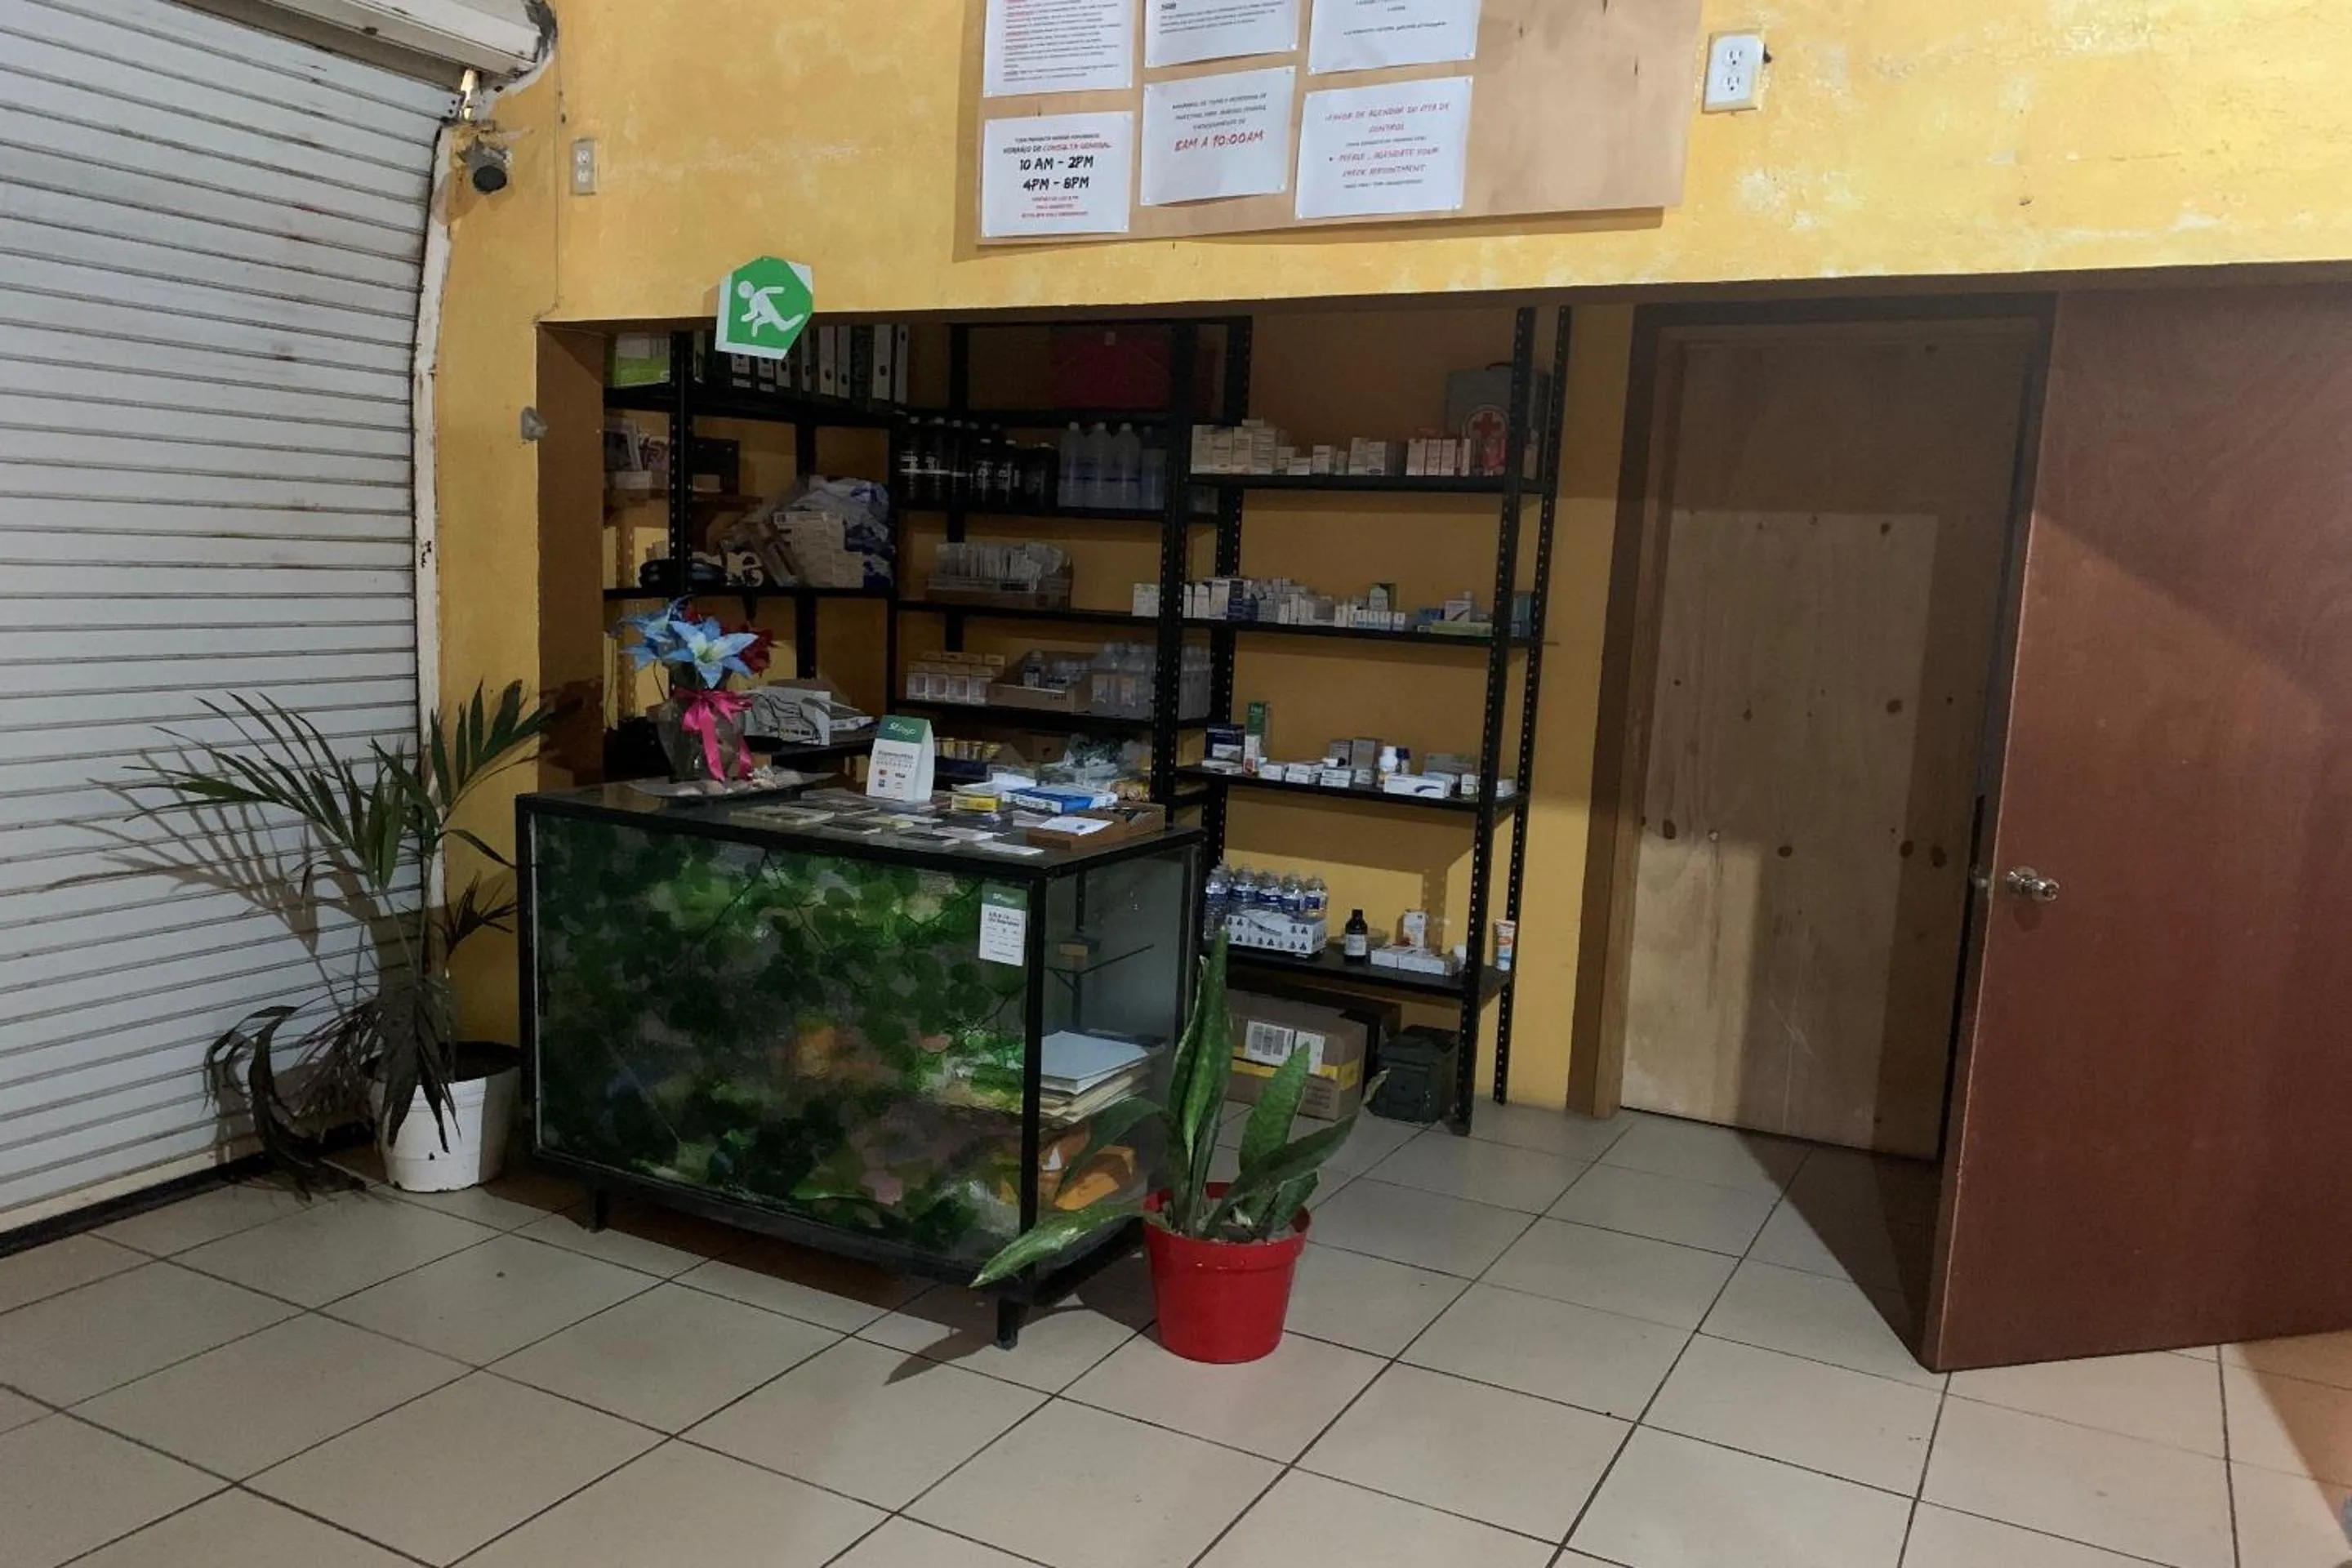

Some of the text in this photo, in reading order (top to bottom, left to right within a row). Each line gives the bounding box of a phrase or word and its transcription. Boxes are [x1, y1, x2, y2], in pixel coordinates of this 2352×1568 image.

[1213, 129, 1264, 149] 10:00AM
[1020, 158, 1031, 171] 10
[1034, 157, 1054, 171] AM
[1067, 155, 1094, 169] 2PM
[1022, 177, 1049, 191] 4PM
